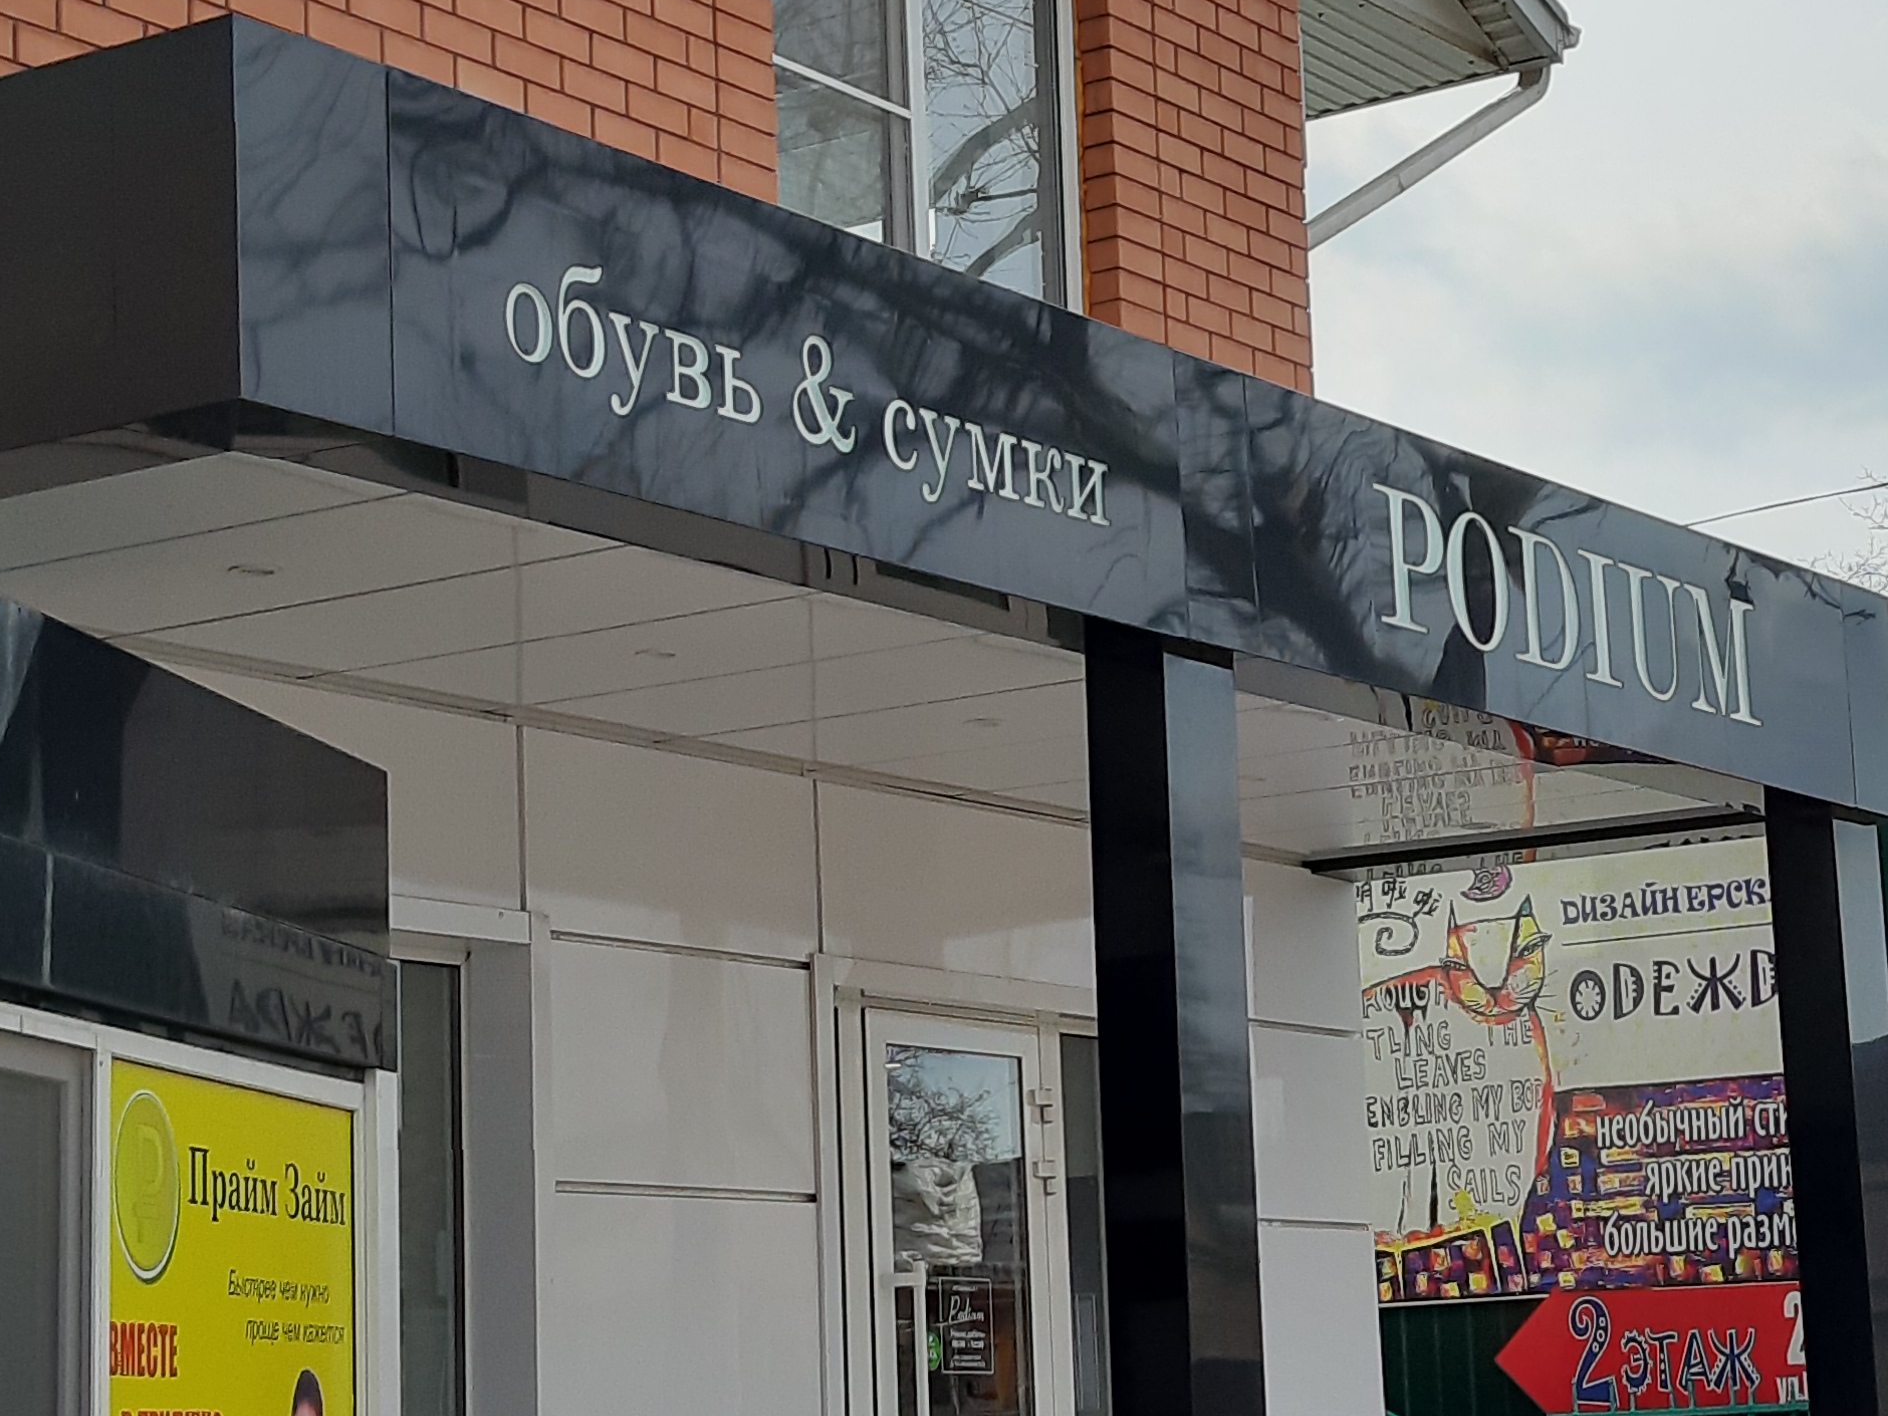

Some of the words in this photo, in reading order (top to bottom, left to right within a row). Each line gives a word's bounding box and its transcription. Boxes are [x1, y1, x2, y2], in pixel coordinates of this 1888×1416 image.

[505, 265, 762, 424] обувь
[792, 335, 857, 454] &
[883, 398, 1111, 526] сумки
[1373, 483, 1763, 727] PODIUM
[1561, 877, 1771, 925] ДИЗАЙНЕРСК
[1395, 1048, 1487, 1090] LEAVES
[1472, 1084, 1504, 1122] MY
[1596, 1097, 1746, 1150] необычный
[1373, 1125, 1472, 1172] FILLING
[1487, 1119, 1526, 1157] MY
[188, 1146, 278, 1222] Прайм
[285, 1162, 346, 1226] Займ
[1645, 1156, 1722, 1202] яркие
[1604, 1210, 1719, 1256] большие
[110, 1321, 177, 1378] ВМЕСТЕ
[1569, 1295, 1619, 1407] 2
[1621, 1327, 1760, 1395] ЭТАЖ
